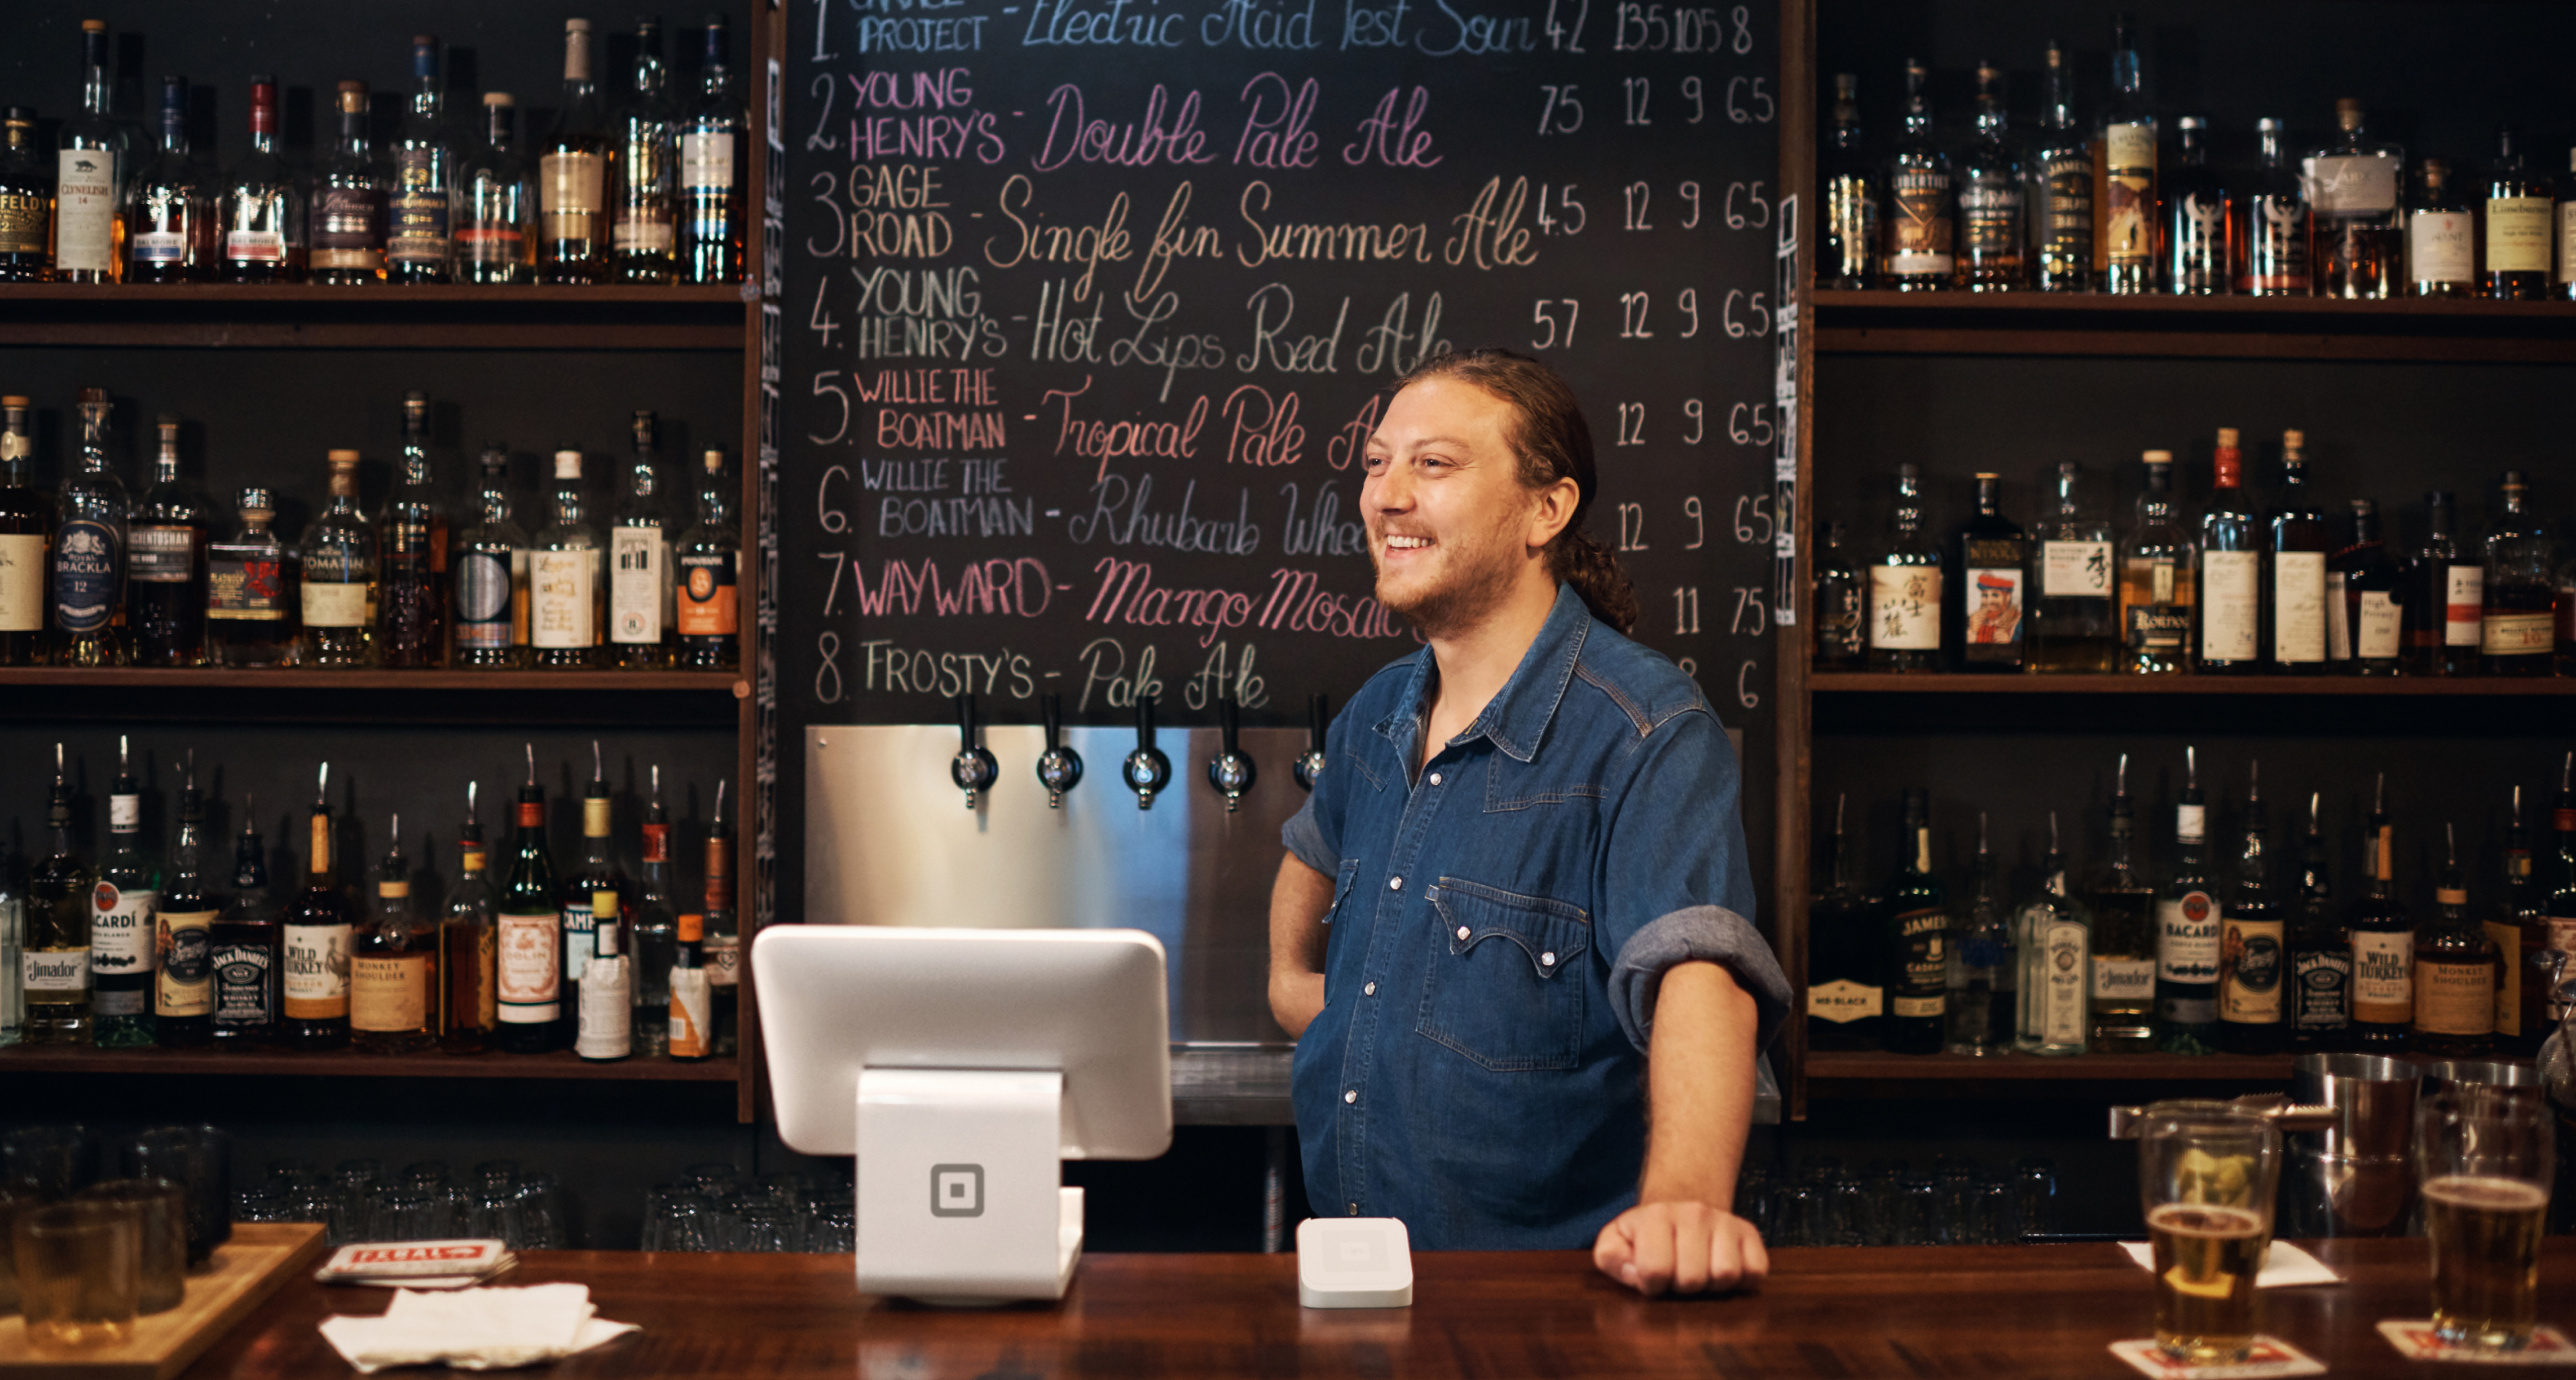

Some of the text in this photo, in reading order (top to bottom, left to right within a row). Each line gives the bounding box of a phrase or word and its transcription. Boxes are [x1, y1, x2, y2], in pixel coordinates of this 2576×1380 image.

[859, 15, 989, 54] PROJECT
[1022, 0, 1185, 47] Electric
[1201, 0, 1321, 48] Acid
[1339, 0, 1411, 51] Test
[1415, 0, 1537, 55] Sour
[1731, 5, 1753, 54] 8
[849, 68, 973, 110] YOUNG
[850, 110, 1005, 163] HENRY'S
[1032, 84, 1218, 172] Double
[1234, 72, 1319, 168] Pale
[1343, 85, 1444, 168] Ale
[1622, 77, 1652, 124] 12
[1681, 75, 1704, 123] 9
[61, 185, 109, 196] CLYNELISH
[849, 164, 951, 209] GAGE
[77, 196, 89, 205] 14
[850, 209, 952, 258] ROAD
[984, 174, 1134, 302] Single
[1237, 180, 1432, 267] Summer
[1444, 176, 1538, 270] Ale
[1624, 181, 1653, 230] 12
[1679, 181, 1700, 228] 9
[851, 266, 981, 318] YOUNG
[1031, 278, 1104, 362] Hot
[1109, 291, 1225, 402] Lips
[1236, 282, 1350, 373] Red
[1620, 291, 1654, 338] 12
[1679, 288, 1699, 338] 9
[854, 369, 998, 406] WILLIE THE
[877, 409, 1005, 451] BOATMAN
[1041, 375, 1209, 482] Tropical
[1222, 384, 1306, 466] Pale
[1616, 402, 1646, 446] 12
[1683, 399, 1704, 445] 9
[862, 458, 1012, 495] WILLIE THE
[879, 496, 1033, 537] BOATMAN
[1069, 473, 1259, 556] Rhubarb
[1280, 480, 1367, 557] Whea
[1618, 502, 1649, 551] 12
[1684, 495, 1704, 550] 9
[56, 561, 111, 573] BRACKLA
[303, 556, 365, 571] TOMATIN
[74, 580, 87, 593] 12
[853, 557, 1053, 619] WAYWARD
[1086, 557, 1262, 649] Mango
[1672, 587, 1701, 636] 11
[860, 639, 1034, 699] FROSTY'S
[1079, 637, 1163, 713] Pale
[1184, 640, 1270, 711] Ale
[1737, 660, 1760, 709] 6
[92, 911, 136, 928] CARDÍ
[2166, 922, 2220, 938] BACARD
[214, 951, 235, 970] JACK
[288, 945, 317, 961] WILD
[2366, 951, 2399, 966] WILD
[29, 960, 78, 981] Jimador
[285, 955, 324, 975] TURKEY
[357, 961, 400, 971] MONKEY
[2358, 961, 2404, 981] TURKEY
[2437, 965, 2484, 976] MONKEY
[355, 970, 406, 981] SHOULDER
[2432, 974, 2487, 985] SHOULDER
[359, 1247, 442, 1263] FERAL
